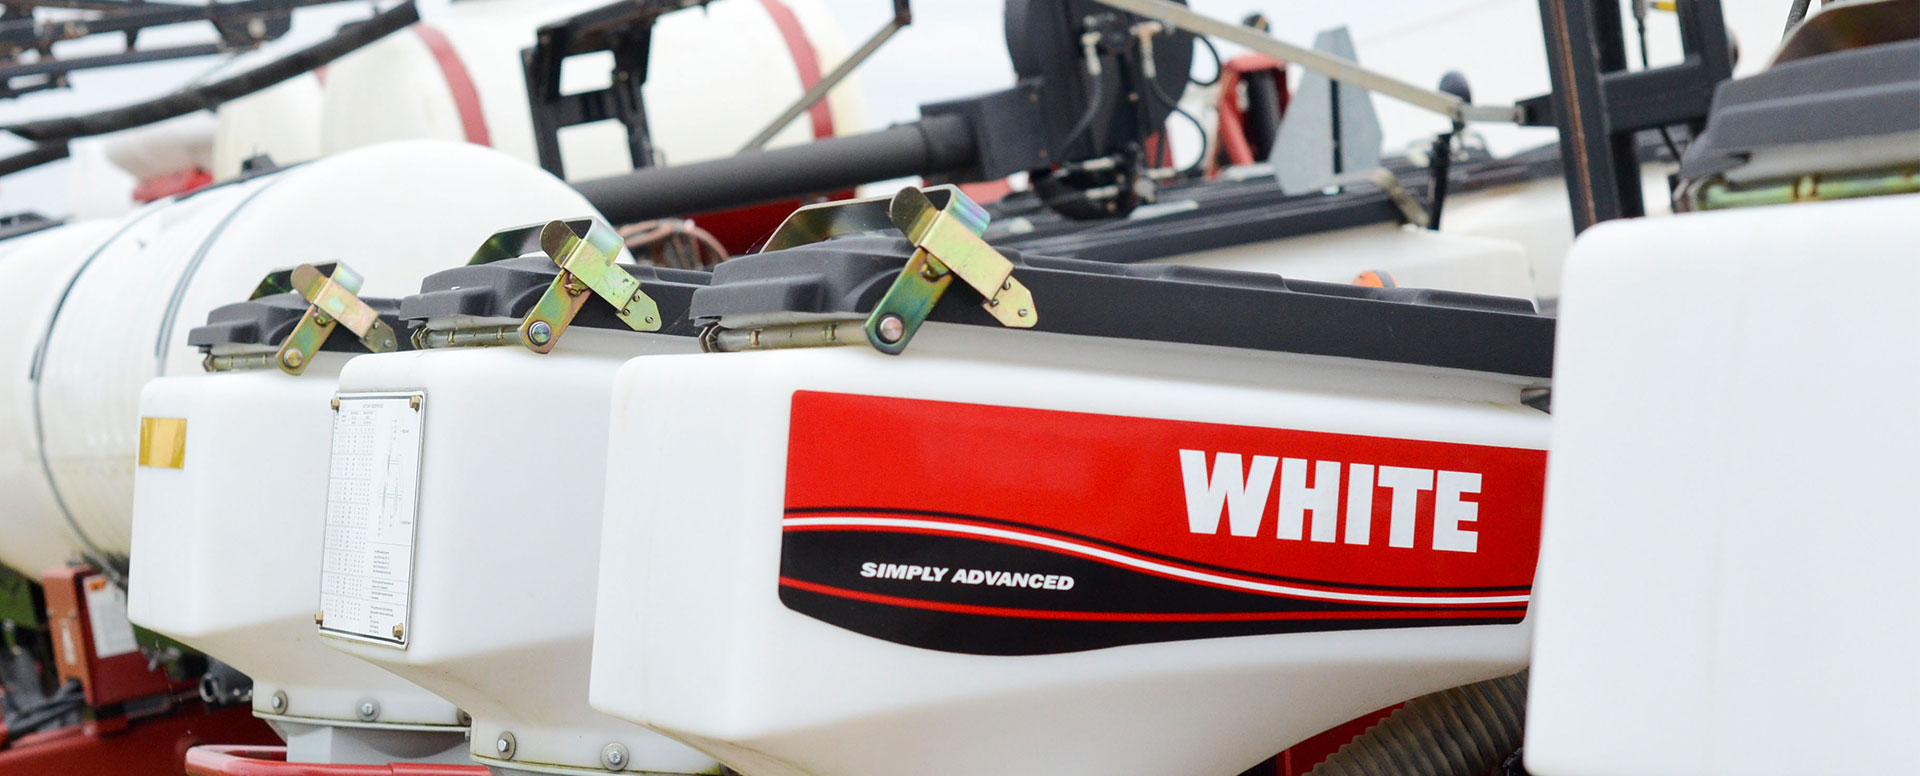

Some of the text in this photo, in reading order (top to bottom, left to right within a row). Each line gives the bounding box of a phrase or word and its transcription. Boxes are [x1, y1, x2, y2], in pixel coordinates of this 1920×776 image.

[1178, 448, 1483, 553] WHITE
[859, 561, 1075, 592] SIMPLY ADVANCED
